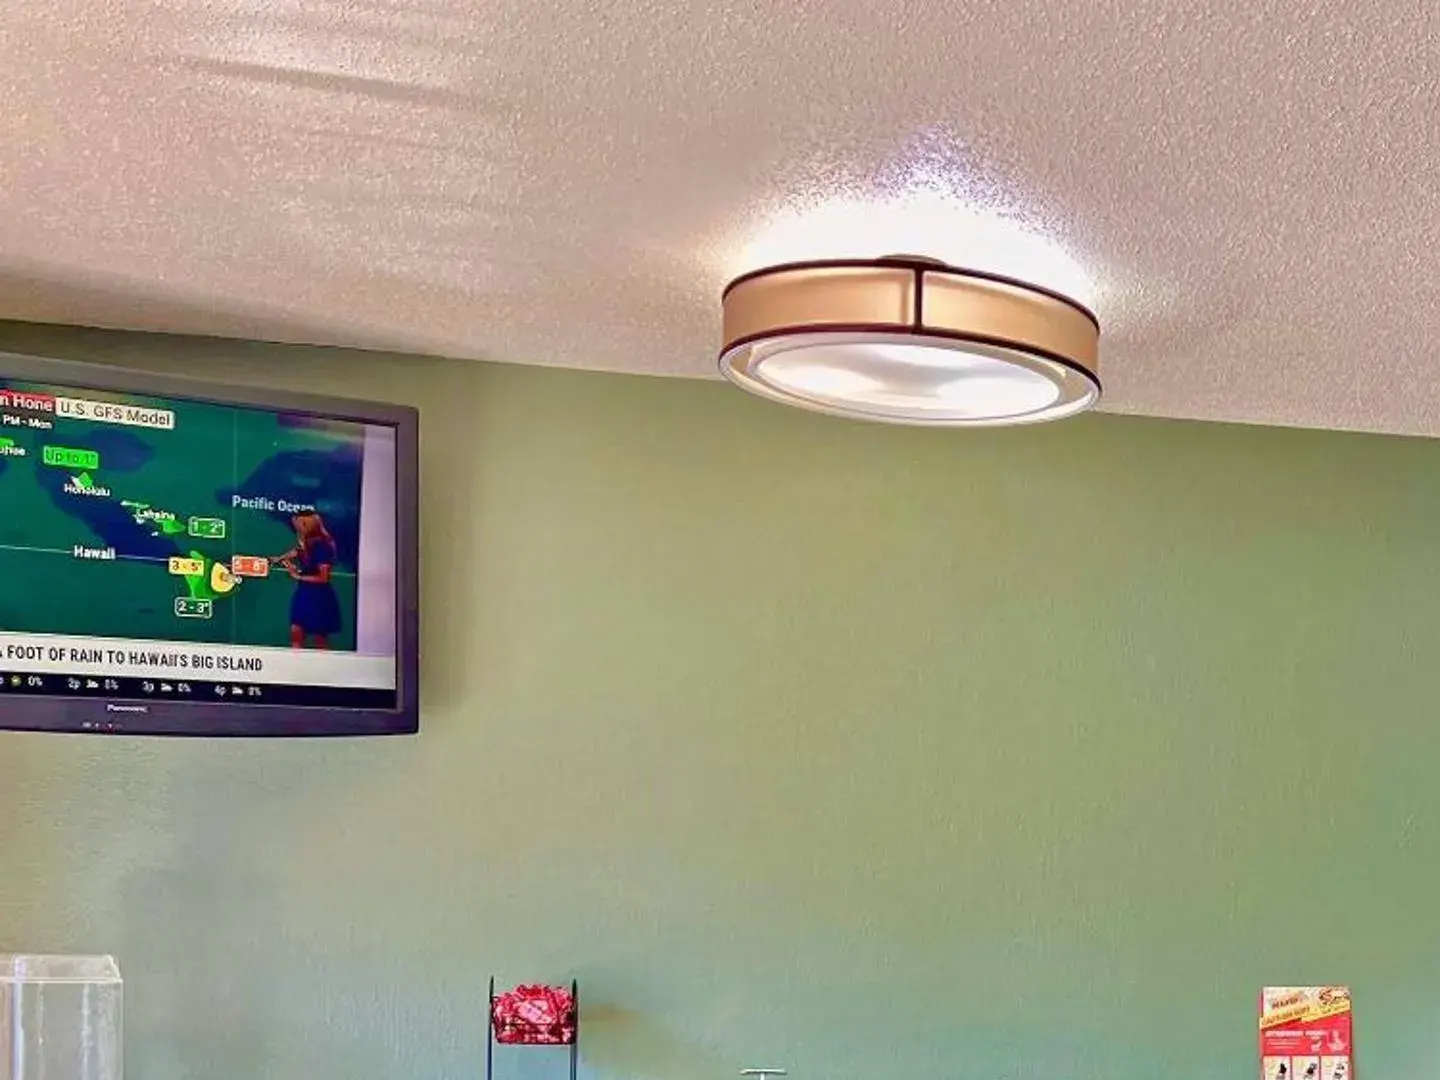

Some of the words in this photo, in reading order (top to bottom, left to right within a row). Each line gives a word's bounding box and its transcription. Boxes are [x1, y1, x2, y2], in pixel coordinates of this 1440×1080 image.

[13, 393, 53, 411] Hone
[61, 403, 89, 416] U.S.
[94, 405, 123, 420] GFS
[127, 409, 170, 426] Model
[231, 495, 275, 511] Pacific
[74, 545, 116, 560] Hawaii
[7, 645, 44, 660] FOOT
[49, 647, 66, 661] OF
[70, 648, 102, 663] RAIN
[107, 650, 125, 664] TO
[191, 654, 214, 669] BIG
[217, 656, 263, 671] ISLAND
